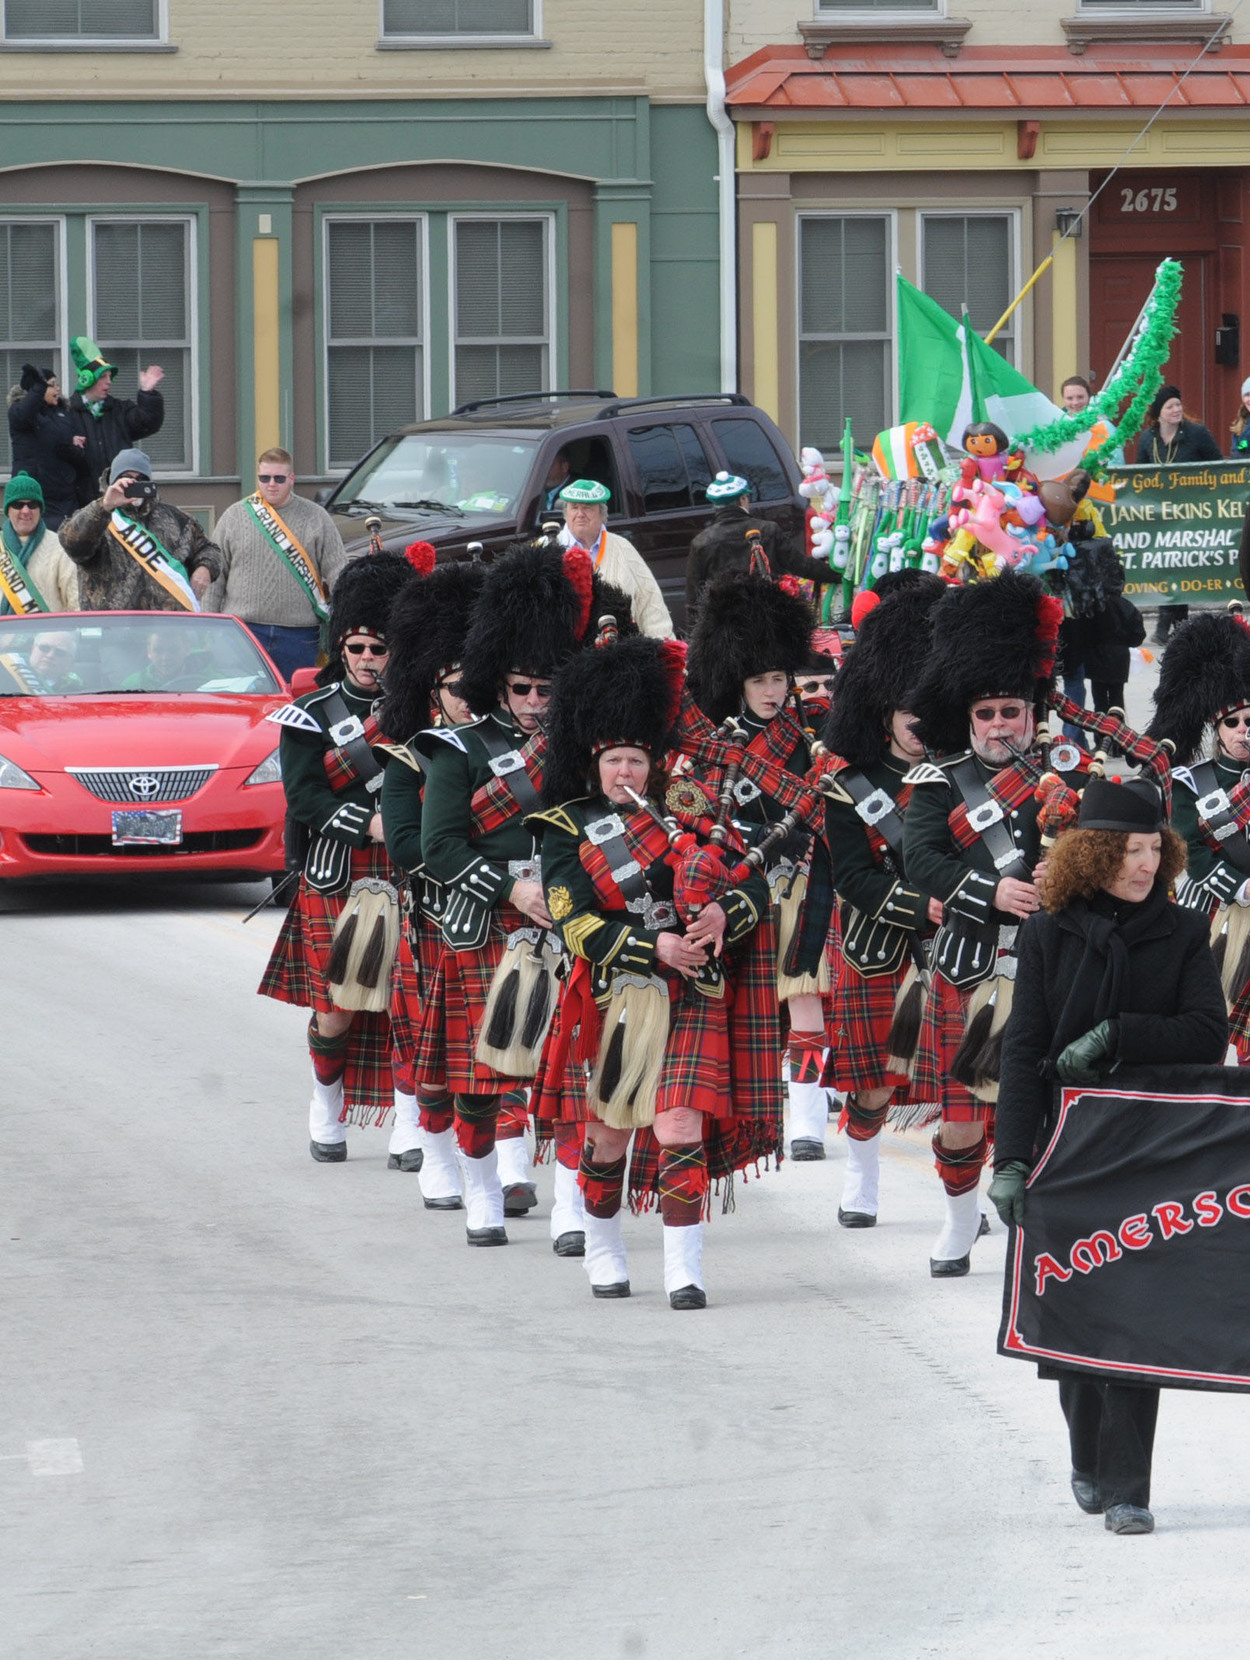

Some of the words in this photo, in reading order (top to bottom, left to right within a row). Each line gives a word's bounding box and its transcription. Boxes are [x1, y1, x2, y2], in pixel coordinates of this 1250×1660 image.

[1121, 187, 1177, 212] 2675
[1132, 472, 1165, 494] God,
[1168, 468, 1217, 490] Family
[1220, 467, 1246, 484] and
[1110, 502, 1155, 526] JANE
[1162, 500, 1212, 520] EKINS
[254, 507, 288, 545] GRAND
[1155, 528, 1235, 548] MARSHAL
[116, 523, 169, 573] AIDE
[1142, 550, 1224, 569] PATRICK'S
[1181, 579, 1223, 592] DO-ER
